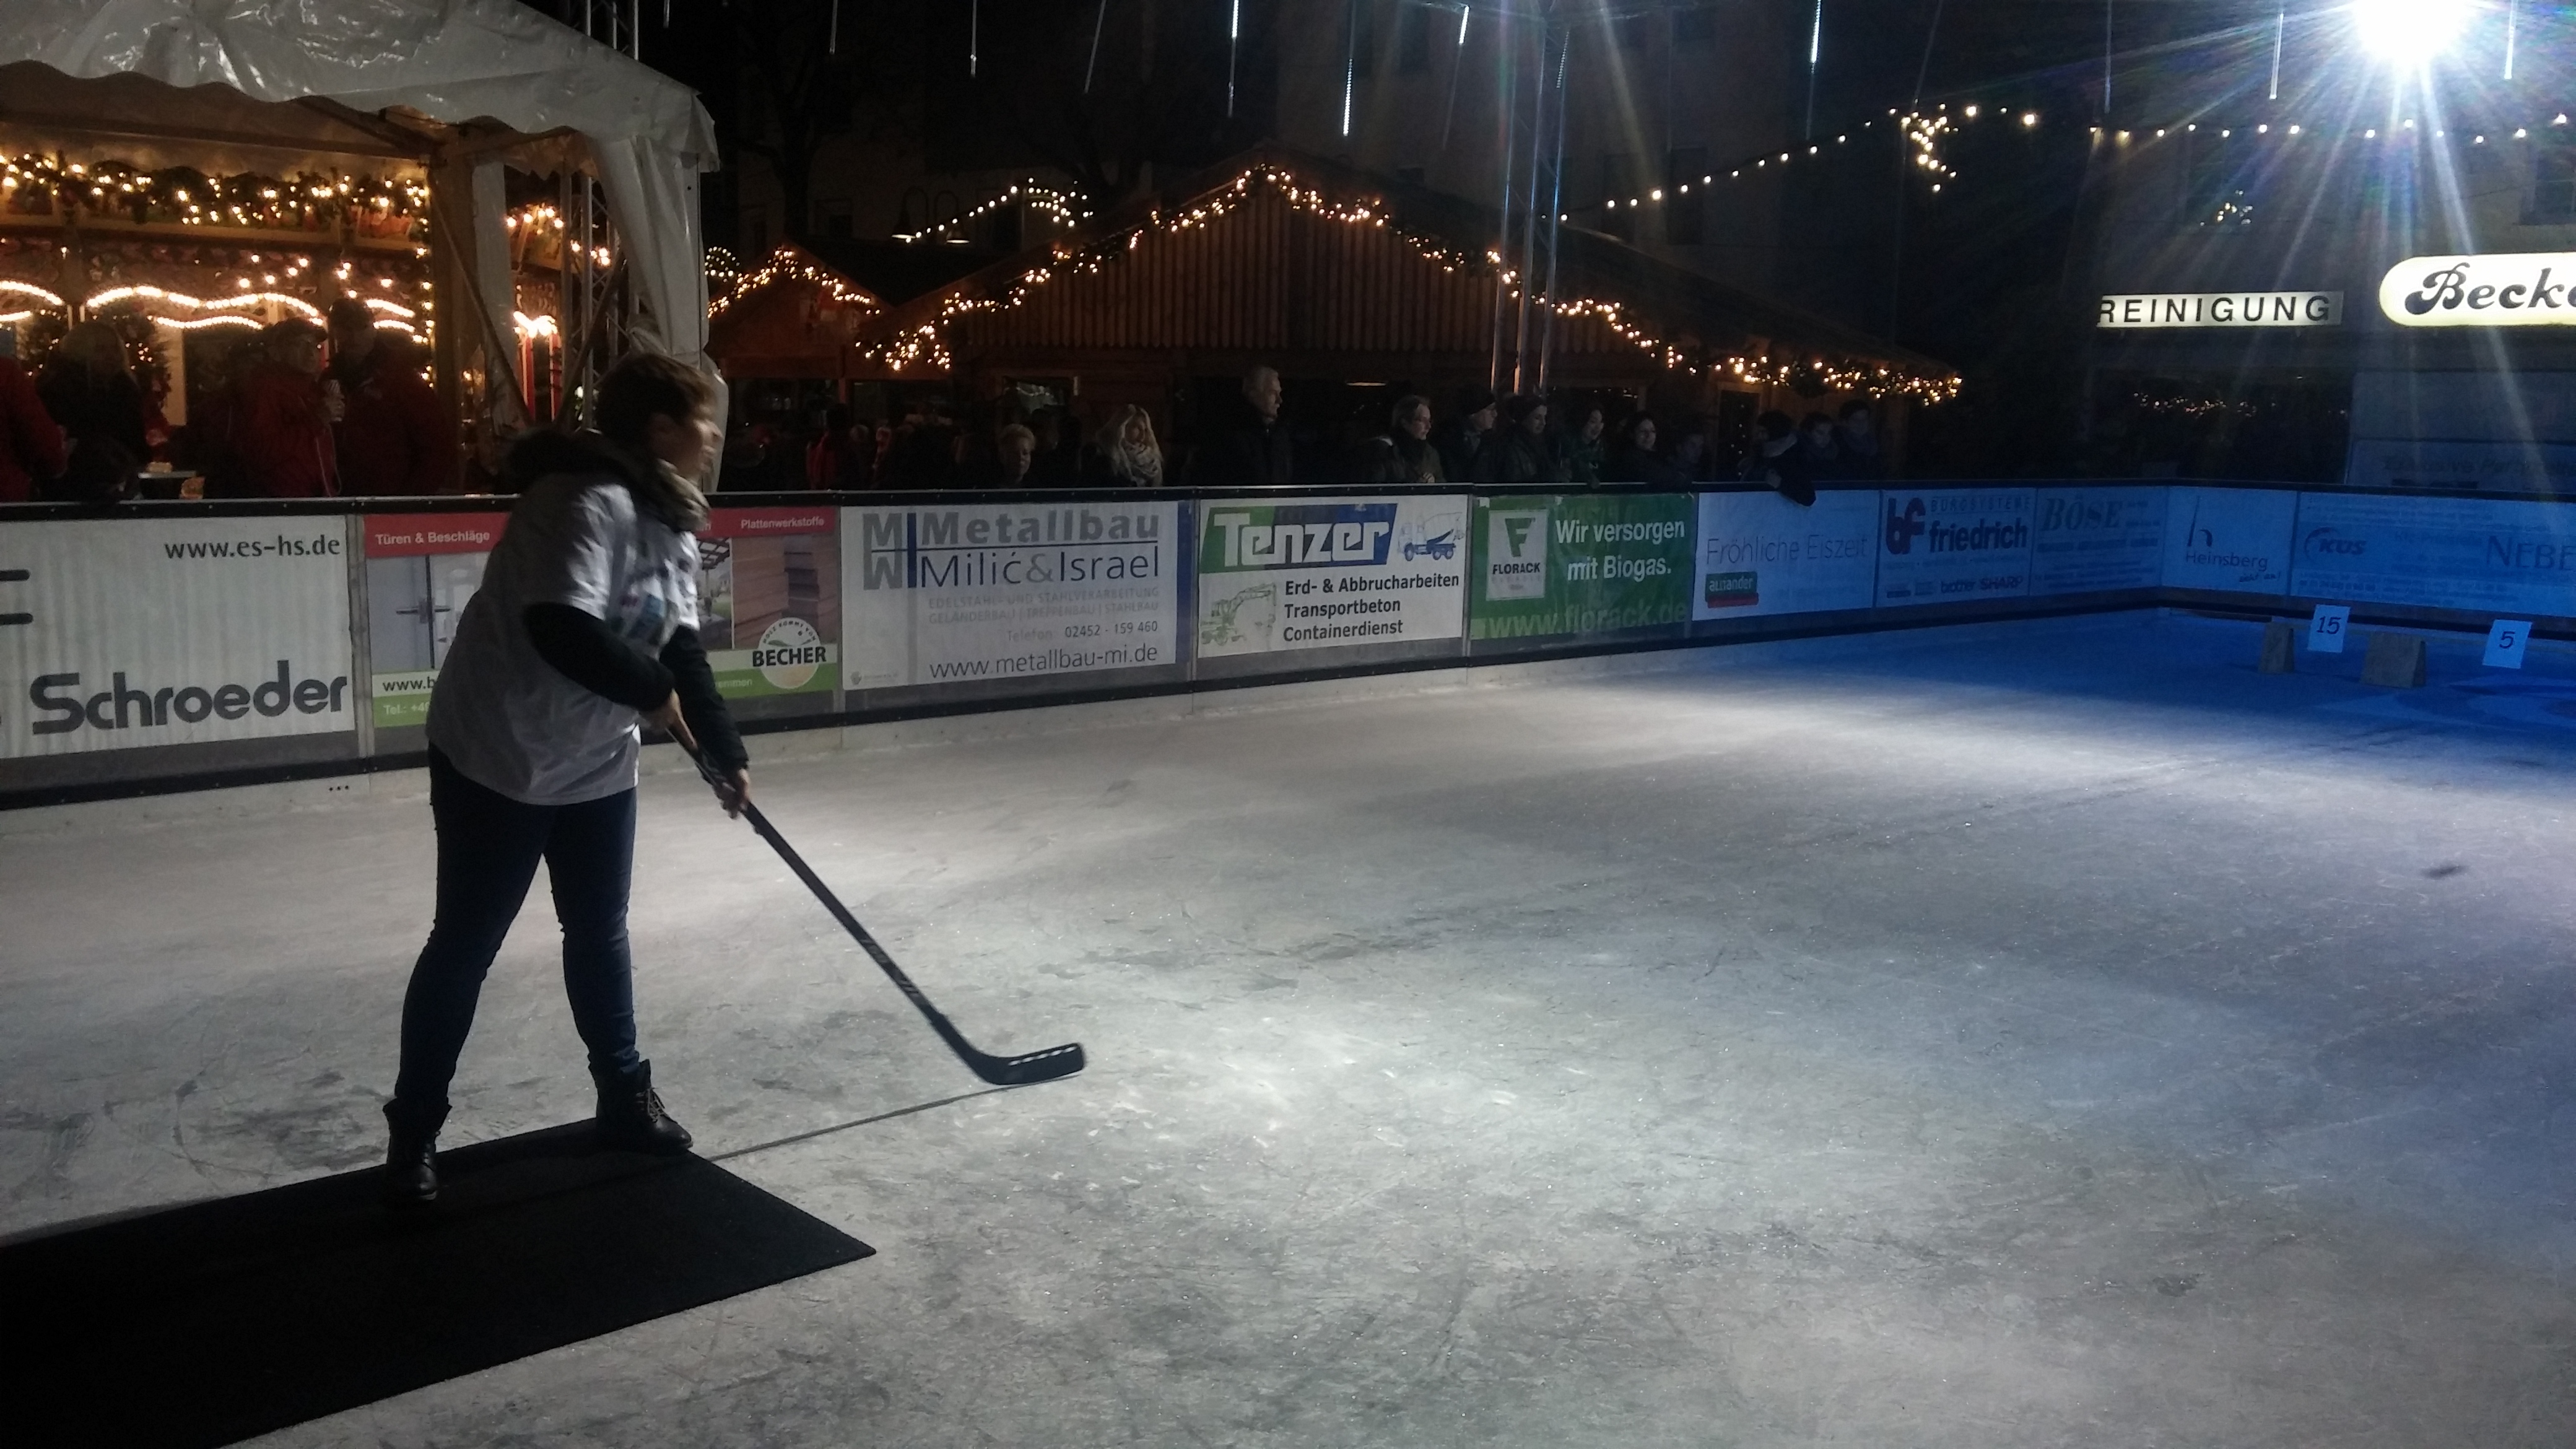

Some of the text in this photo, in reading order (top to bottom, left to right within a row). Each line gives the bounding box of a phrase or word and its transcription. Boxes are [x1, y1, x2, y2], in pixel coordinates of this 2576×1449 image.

[2097, 295, 2330, 323] REINIGUNG
[741, 516, 825, 529] Plattenwerkstoffe
[921, 509, 1159, 546] Metallbau
[1556, 520, 1685, 544] Wir versorgen
[164, 534, 340, 558] www.es-hs.de
[375, 529, 490, 545] Türen & Beschläge
[1213, 512, 1390, 568] Tenzer
[1929, 517, 2028, 553] friedrich
[1706, 534, 1868, 564] Fröhliche Eiszeit
[1492, 562, 1541, 575] FLORACK
[1567, 555, 1671, 582] mit Biogas.
[2185, 550, 2268, 572] Heinsberg
[1285, 573, 1459, 596] Erd- & Abbrucharbeiten
[1105, 601, 1159, 613] STAHLBAU
[1284, 598, 1401, 619] Transportbeton
[1064, 624, 1101, 638] 02452
[1115, 622, 1134, 635] 159
[1137, 620, 1158, 633] 460
[1489, 600, 1687, 638] www.florack.de
[2316, 616, 2341, 635] 15
[1283, 620, 1403, 642] Containerdienst
[2499, 630, 2516, 649] 5
[752, 646, 827, 667] BECHER
[929, 643, 1159, 678] www.metallbau-mi.de
[30, 659, 347, 735] Schroeder
